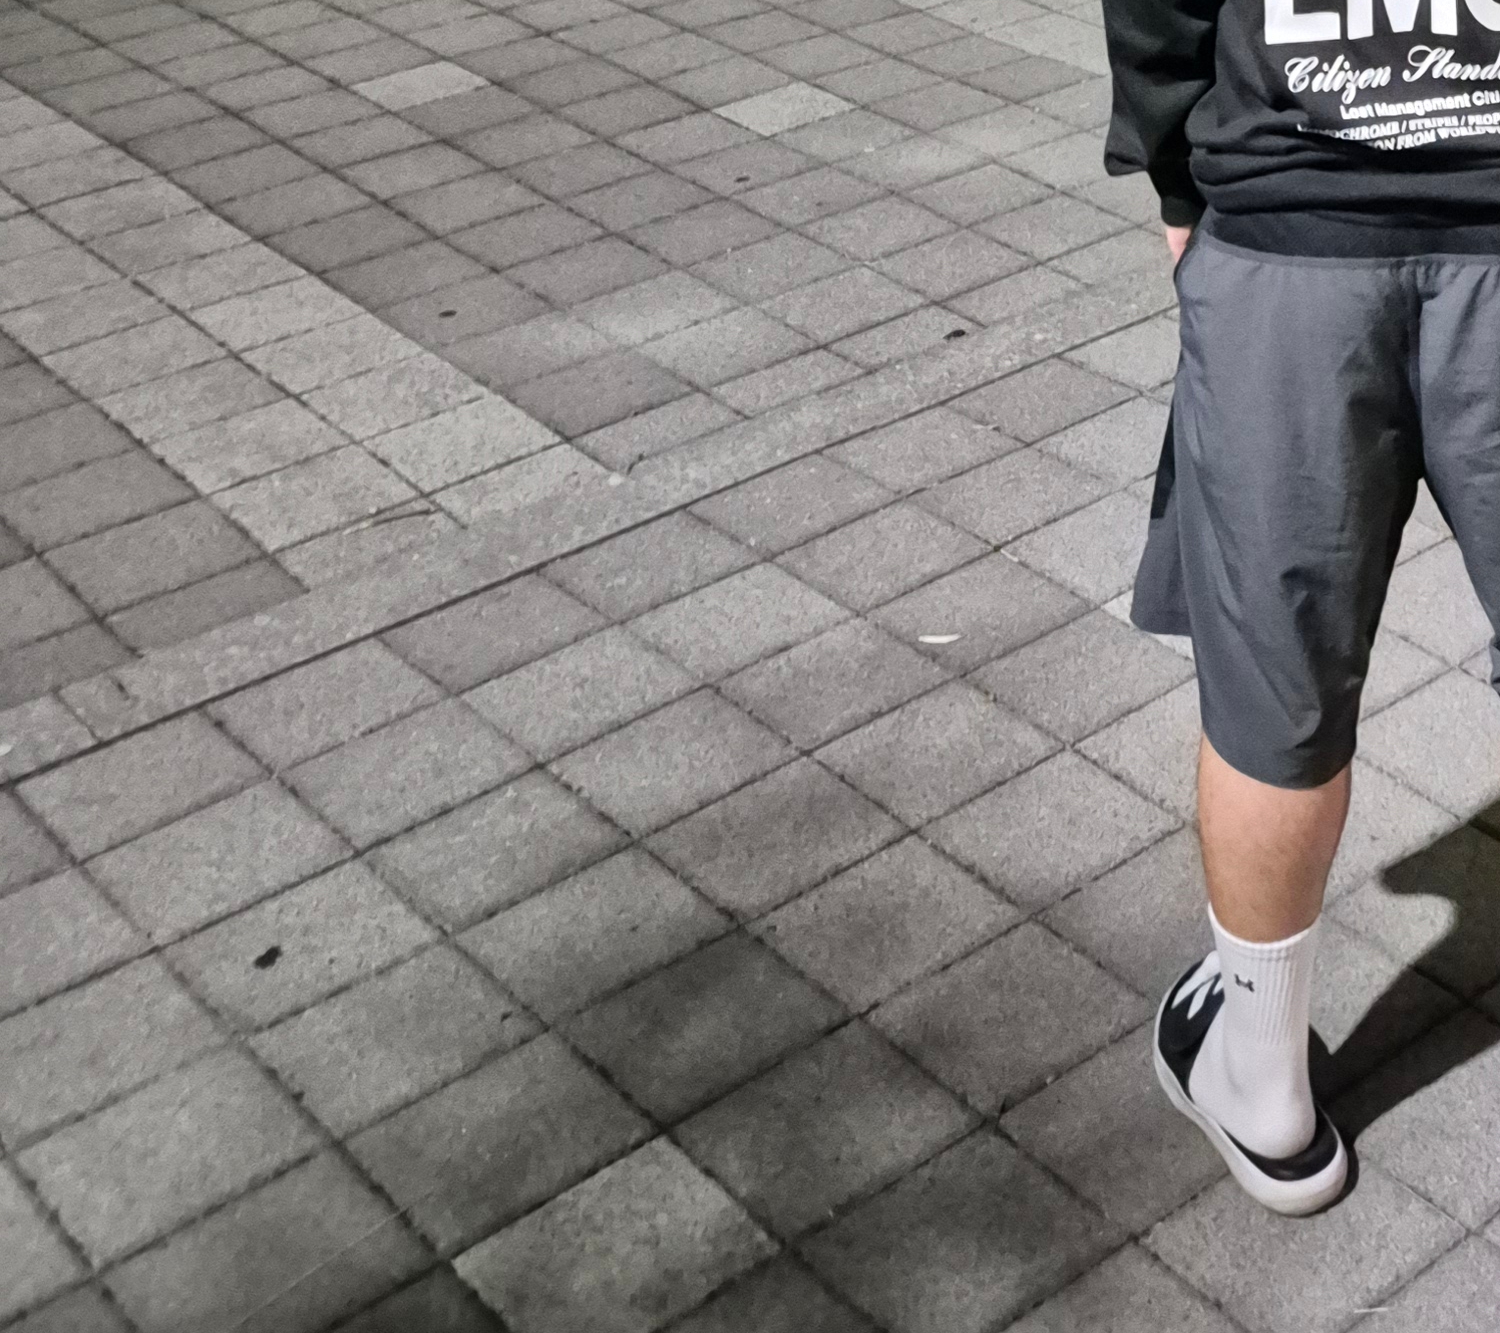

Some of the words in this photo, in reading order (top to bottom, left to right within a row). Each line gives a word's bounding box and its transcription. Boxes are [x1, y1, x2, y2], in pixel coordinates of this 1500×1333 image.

[1284, 54, 1391, 104] Citizen
[1340, 104, 1375, 120] Lost
[1374, 92, 1471, 117] Management
[1409, 115, 1459, 131] STRIPES
[1396, 129, 1436, 151] FROM
